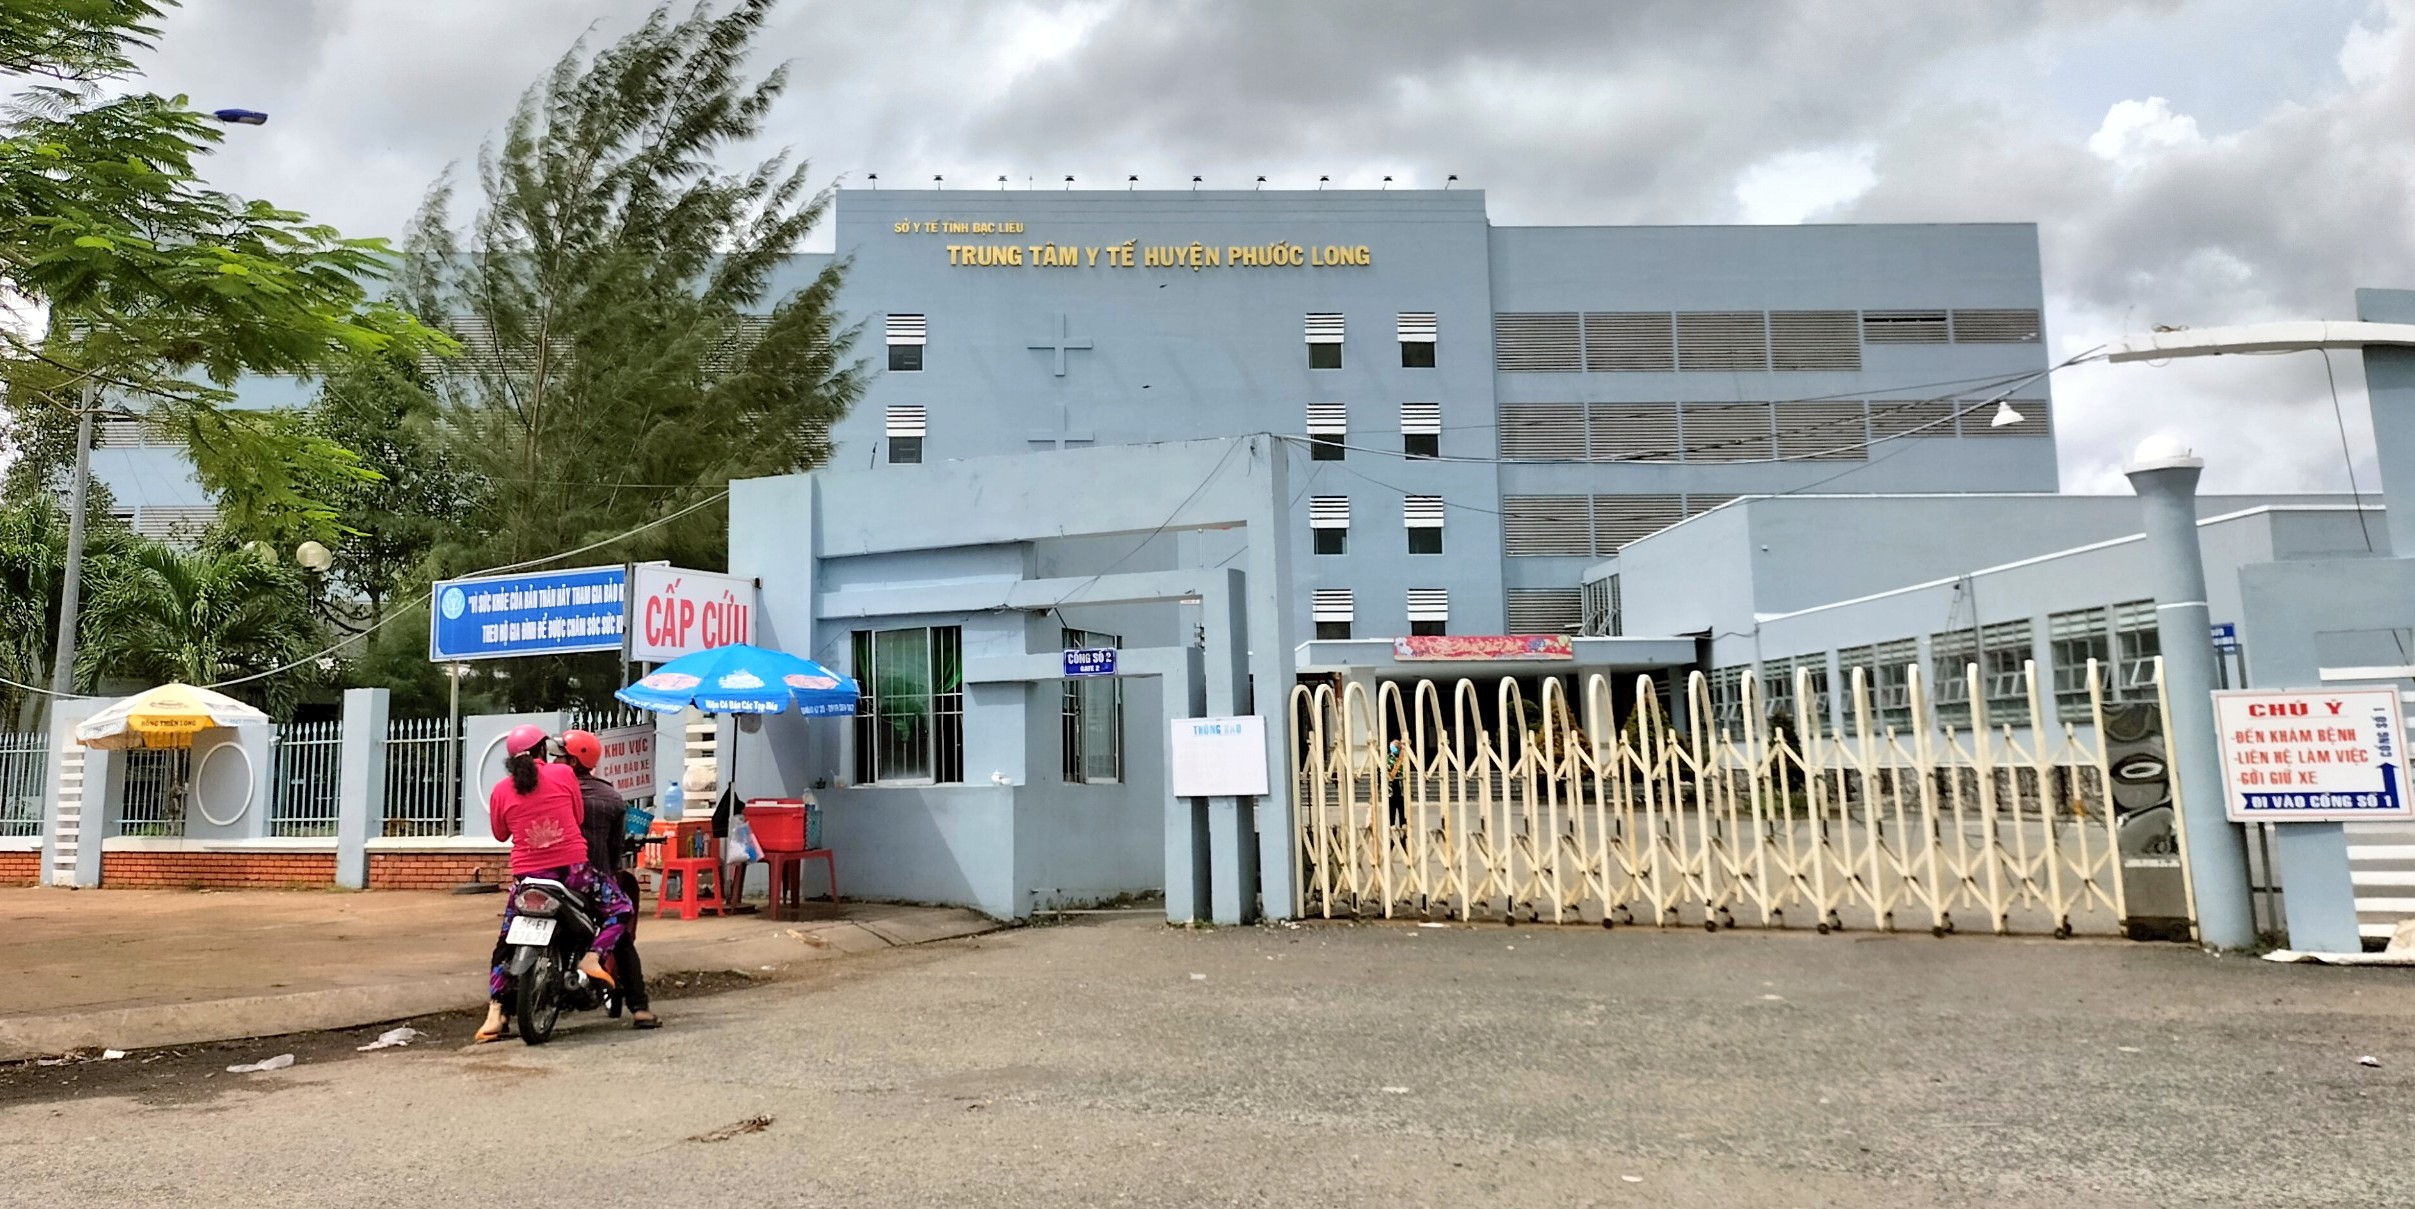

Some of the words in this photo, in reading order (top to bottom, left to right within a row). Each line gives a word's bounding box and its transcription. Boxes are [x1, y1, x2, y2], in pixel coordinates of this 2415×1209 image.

[894, 218, 911, 233] SỞ
[914, 223, 921, 233] Y
[924, 219, 941, 233] TẾ
[972, 222, 995, 236] BẠC
[947, 246, 1022, 266] TRUNG
[1029, 242, 1078, 267] TÂM
[1085, 247, 1101, 267] Y
[1106, 238, 1138, 267] TẾ
[1144, 241, 1220, 272] HUYỆN
[1228, 240, 1304, 267] PHƯỚC
[1311, 246, 1371, 266] LONG
[479, 590, 491, 613] SỨC
[572, 586, 591, 606] THAM
[604, 577, 618, 603] BẢO
[645, 578, 694, 648] CẤP
[702, 589, 747, 649] CỨU
[482, 623, 499, 644] THEO
[587, 612, 601, 636] SÓC
[602, 611, 615, 635] SỨC
[1068, 651, 1091, 664] CỔNG
[1093, 650, 1104, 663] SỐ
[1106, 652, 1112, 662] 2
[2248, 699, 2308, 716] CHÚ
[2325, 699, 2343, 715] Ý
[1193, 724, 1221, 735] THÔNG
[2370, 716, 2388, 728] SỐ
[2270, 727, 2312, 743] KHÁM
[2317, 727, 2356, 745] BỆNH
[604, 742, 625, 758] KHU
[629, 737, 648, 756] VỰC
[641, 759, 650, 770] XE
[2274, 748, 2292, 767] HỆ
[2298, 748, 2330, 764] LÀM
[2336, 748, 2369, 766] VIỆC
[618, 776, 635, 790] MUA
[636, 773, 650, 786] BÁN
[2299, 771, 2318, 784] XE
[2251, 796, 2268, 808] ĐI
[2272, 794, 2306, 808] VÀO
[2310, 791, 2353, 808] CỔNG
[2356, 791, 2378, 808] SỐ
[2384, 795, 2392, 807] 1
